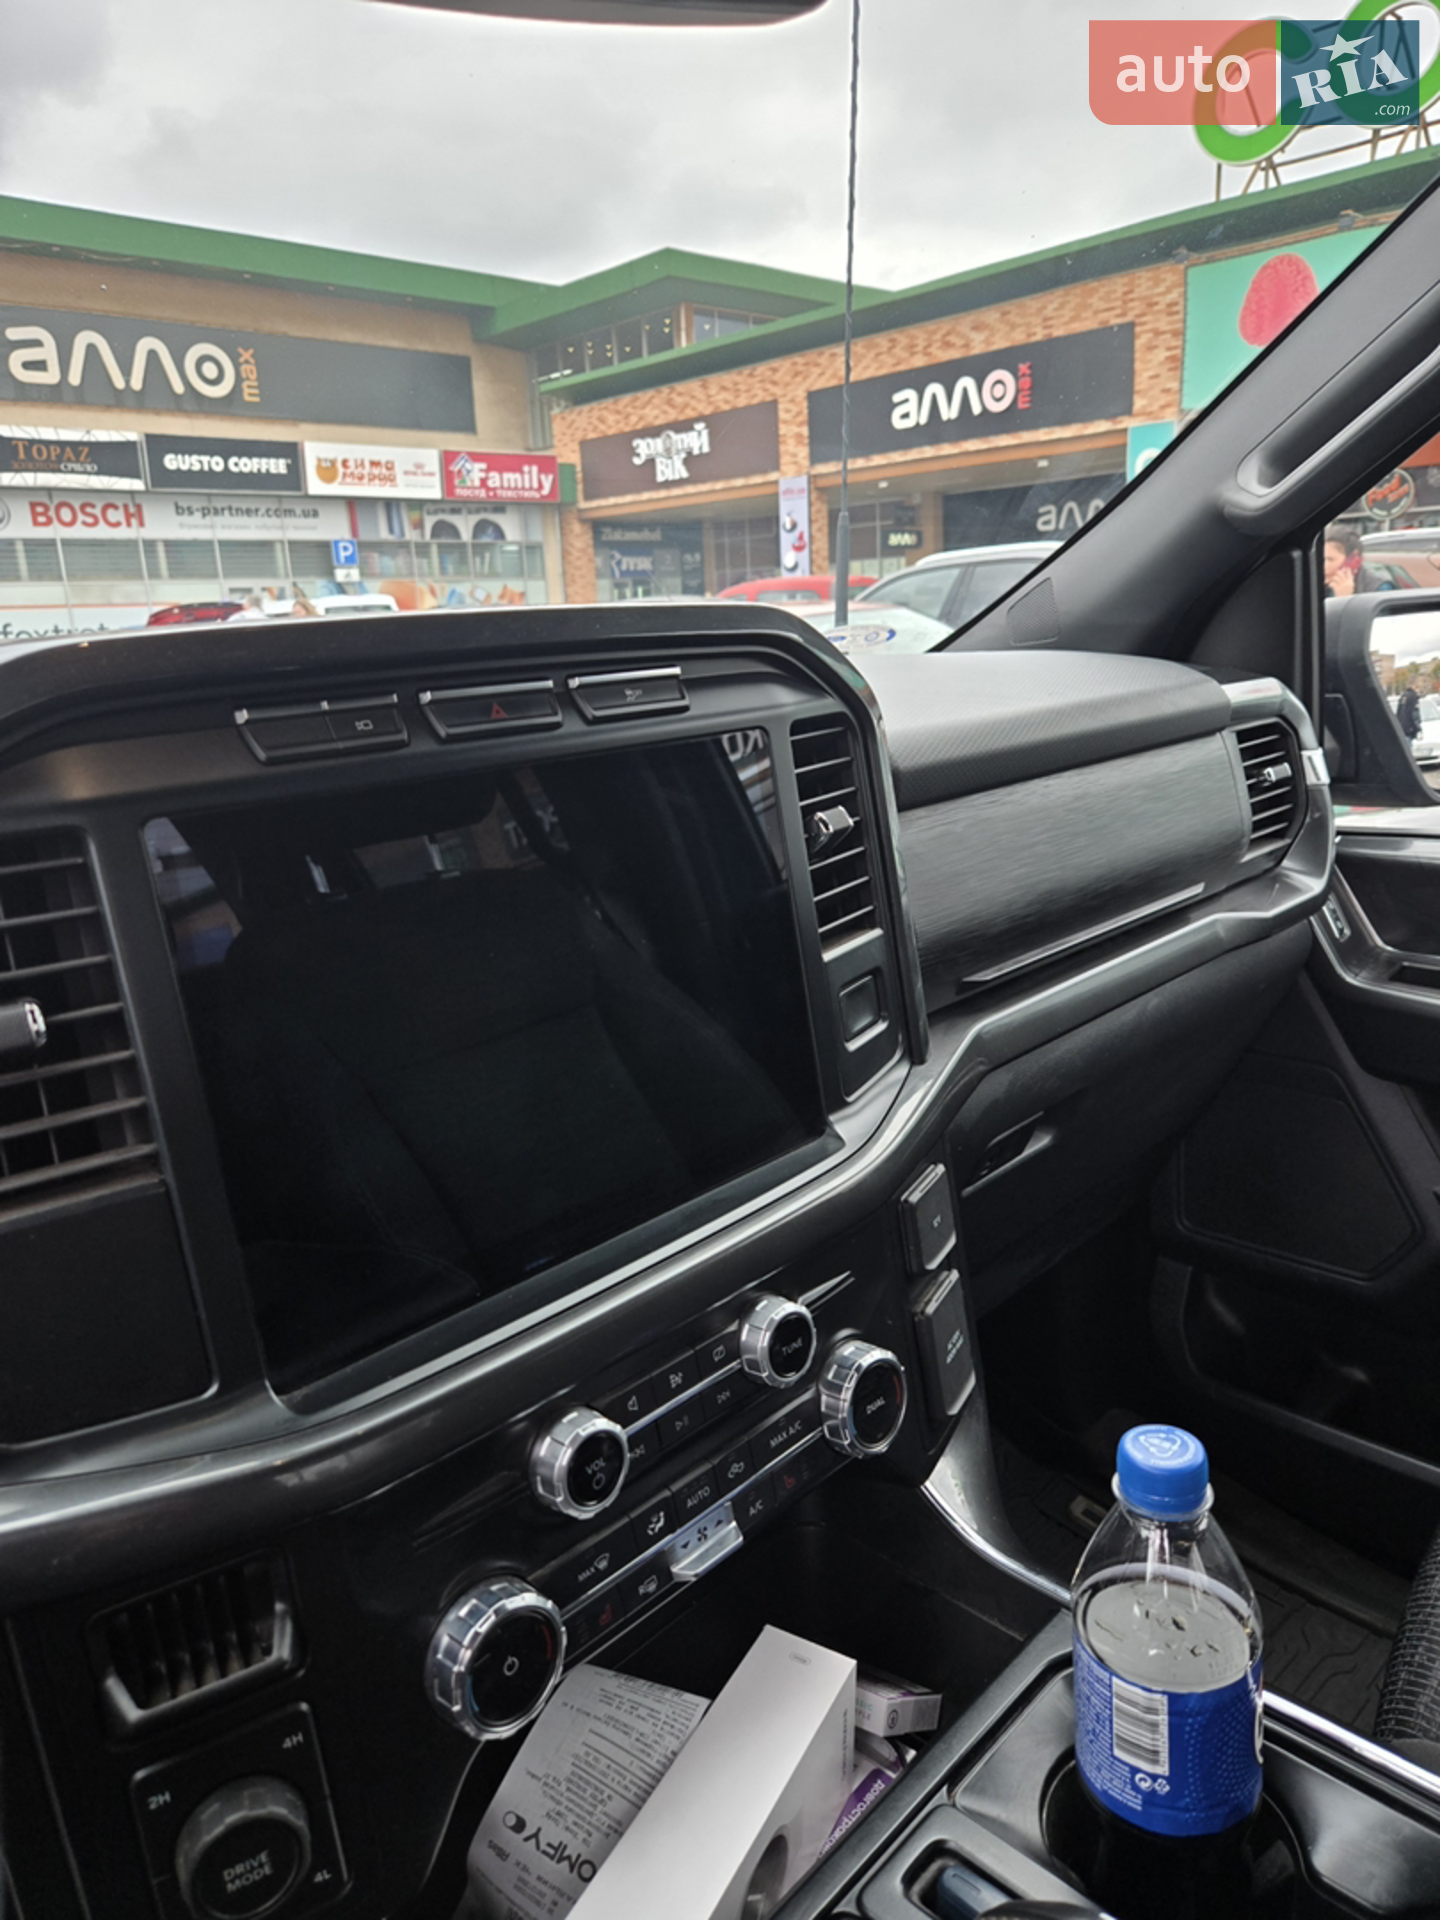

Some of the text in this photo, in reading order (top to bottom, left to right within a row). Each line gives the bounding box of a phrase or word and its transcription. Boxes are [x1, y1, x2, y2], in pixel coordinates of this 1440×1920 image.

[238, 347, 261, 403] max
[1017, 362, 1032, 410] max
[163, 453, 289, 475] GUSTO COFFEE
[472, 462, 554, 496] Family
[29, 501, 146, 528] BOSCH
[174, 502, 320, 519] bs-partner.com.ua
[338, 541, 353, 564] P
[782, 1337, 803, 1356] TUNE
[866, 1396, 886, 1414] DUAL
[769, 1420, 803, 1448] MAX A/C
[585, 1457, 606, 1475] VOL
[686, 1486, 711, 1509] AUTO
[748, 1498, 764, 1517] A/C
[577, 1565, 596, 1583] MAX
[282, 1732, 304, 1748] 4H
[148, 1791, 171, 1810] 2H
[223, 1850, 271, 1882] DRIVE
[523, 1827, 597, 1883] OMFY
[226, 1862, 273, 1894] MODE
[314, 1869, 332, 1884] 4L
